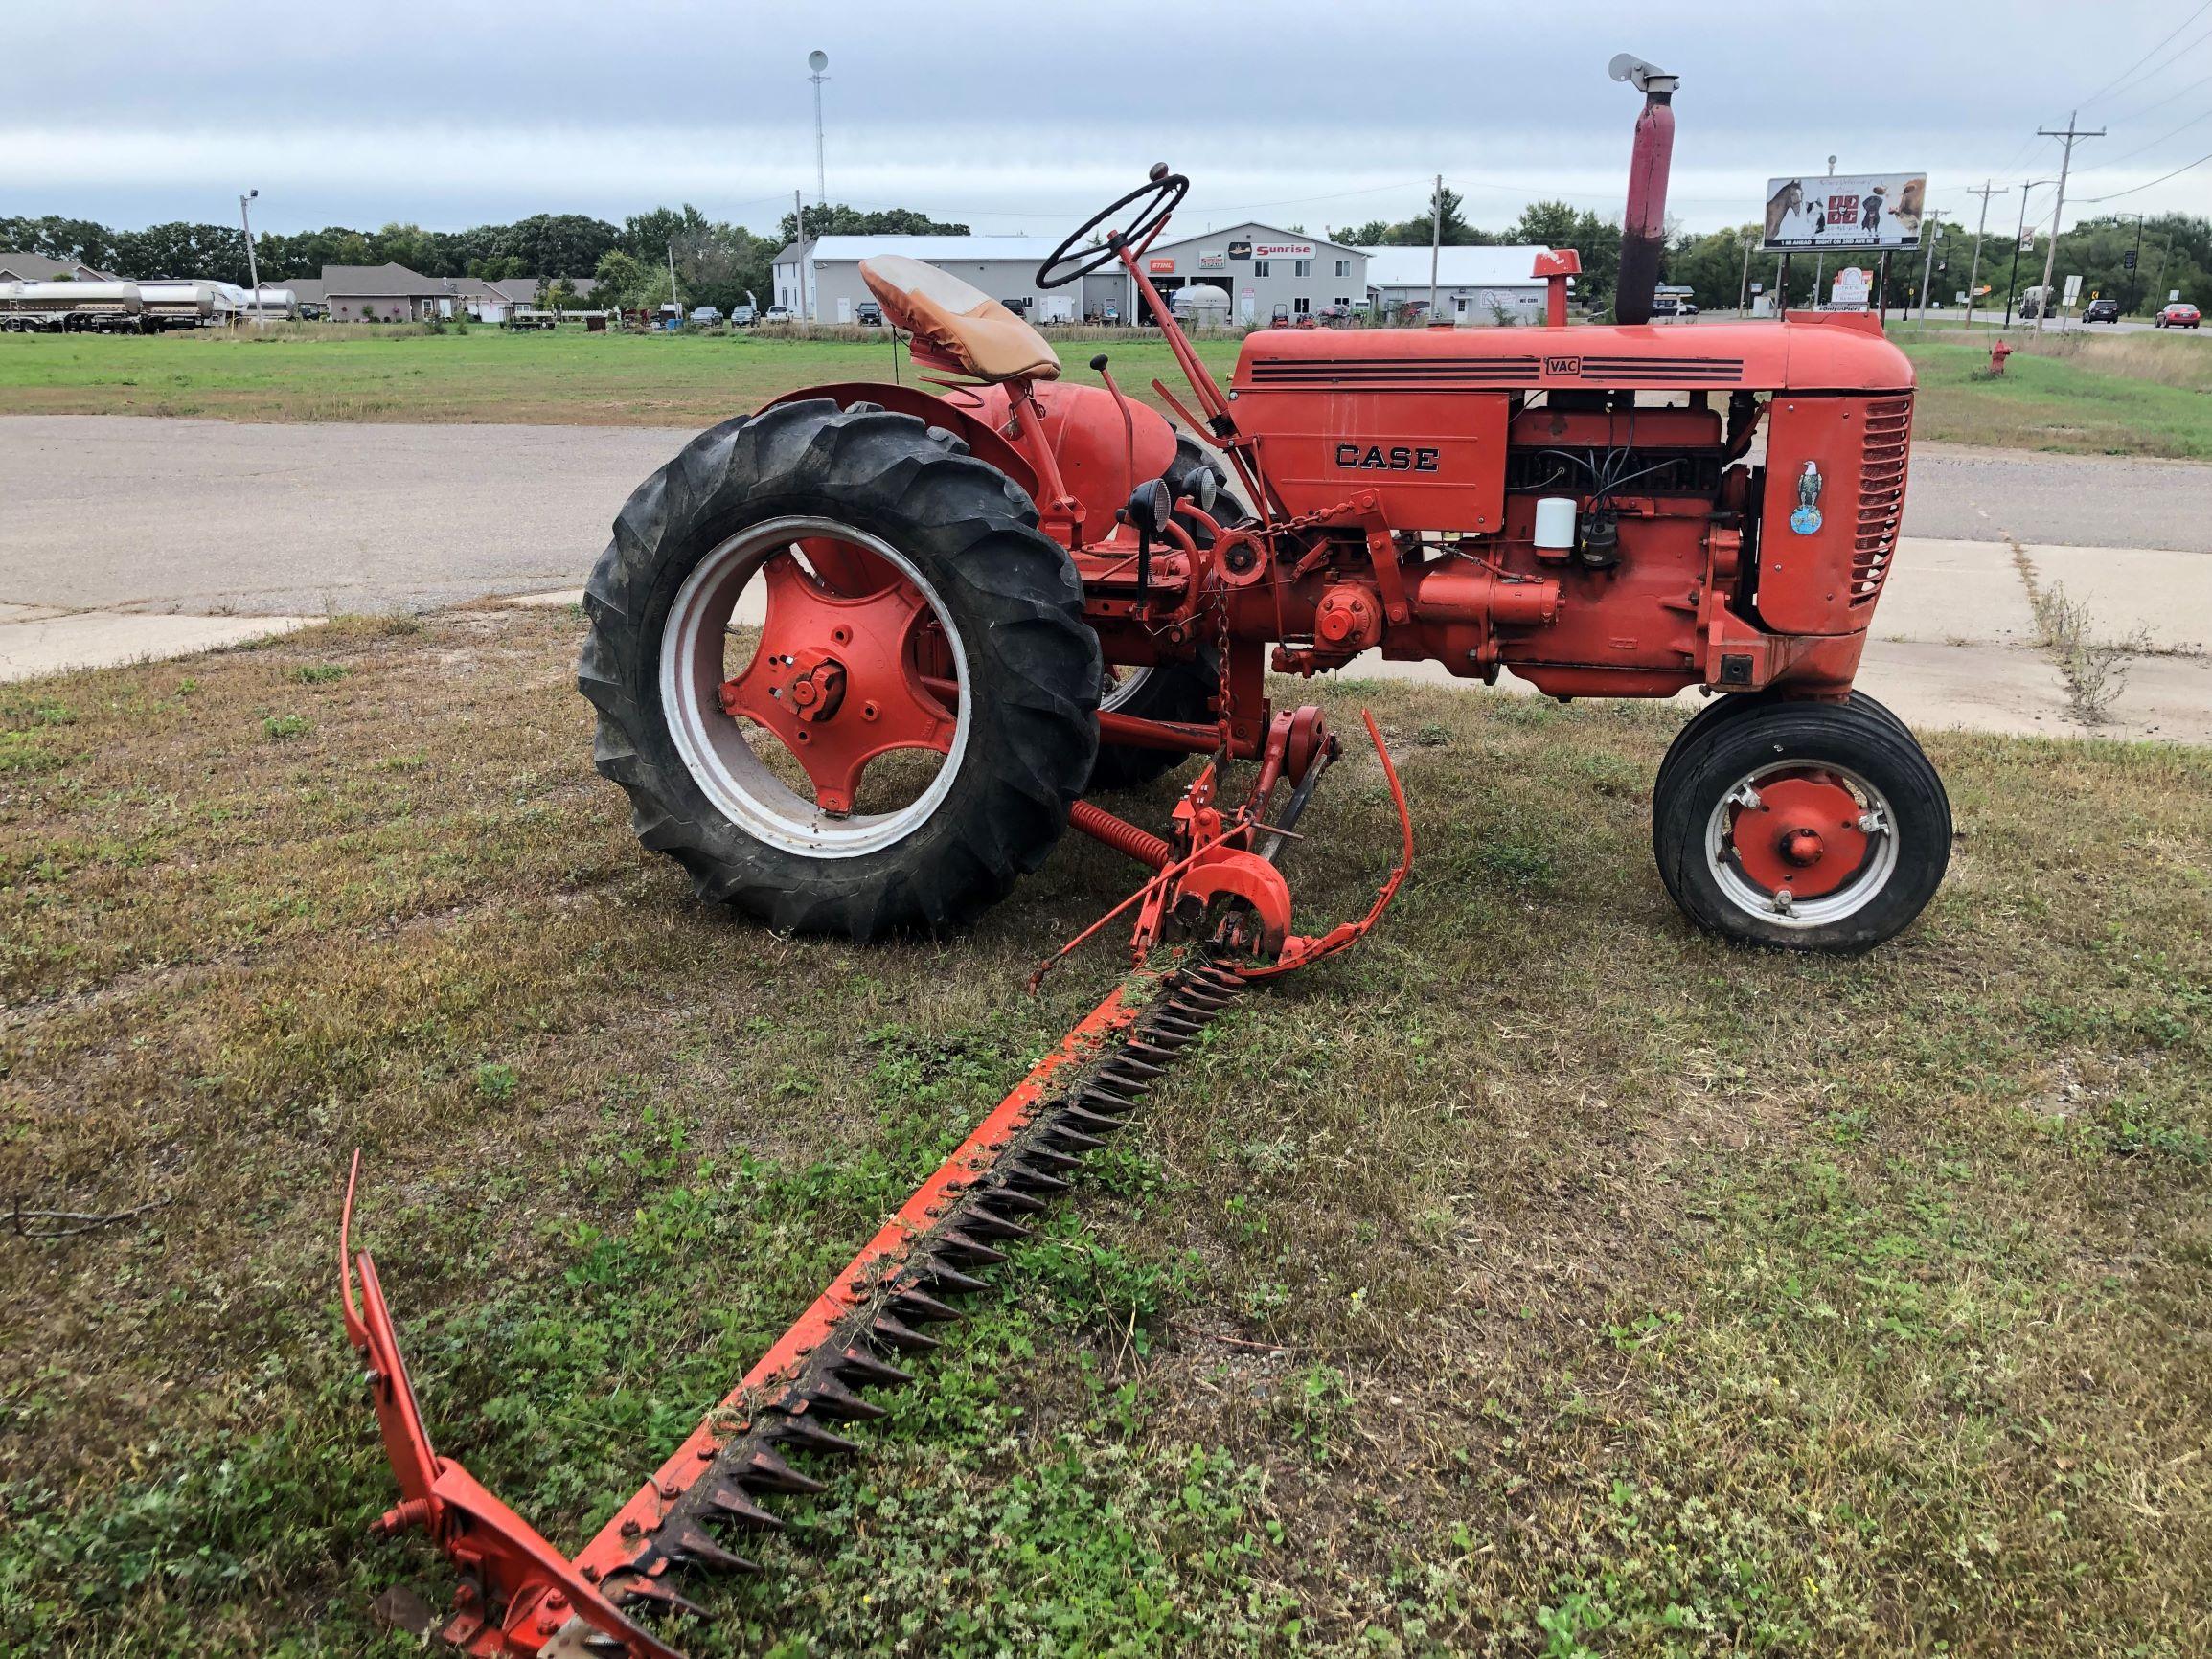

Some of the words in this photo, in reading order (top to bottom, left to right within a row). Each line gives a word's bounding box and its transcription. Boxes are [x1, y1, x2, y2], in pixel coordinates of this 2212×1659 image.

[1256, 244, 1311, 256] Sunrise
[1550, 360, 1577, 372] VAC
[1335, 443, 1440, 472] CASE
